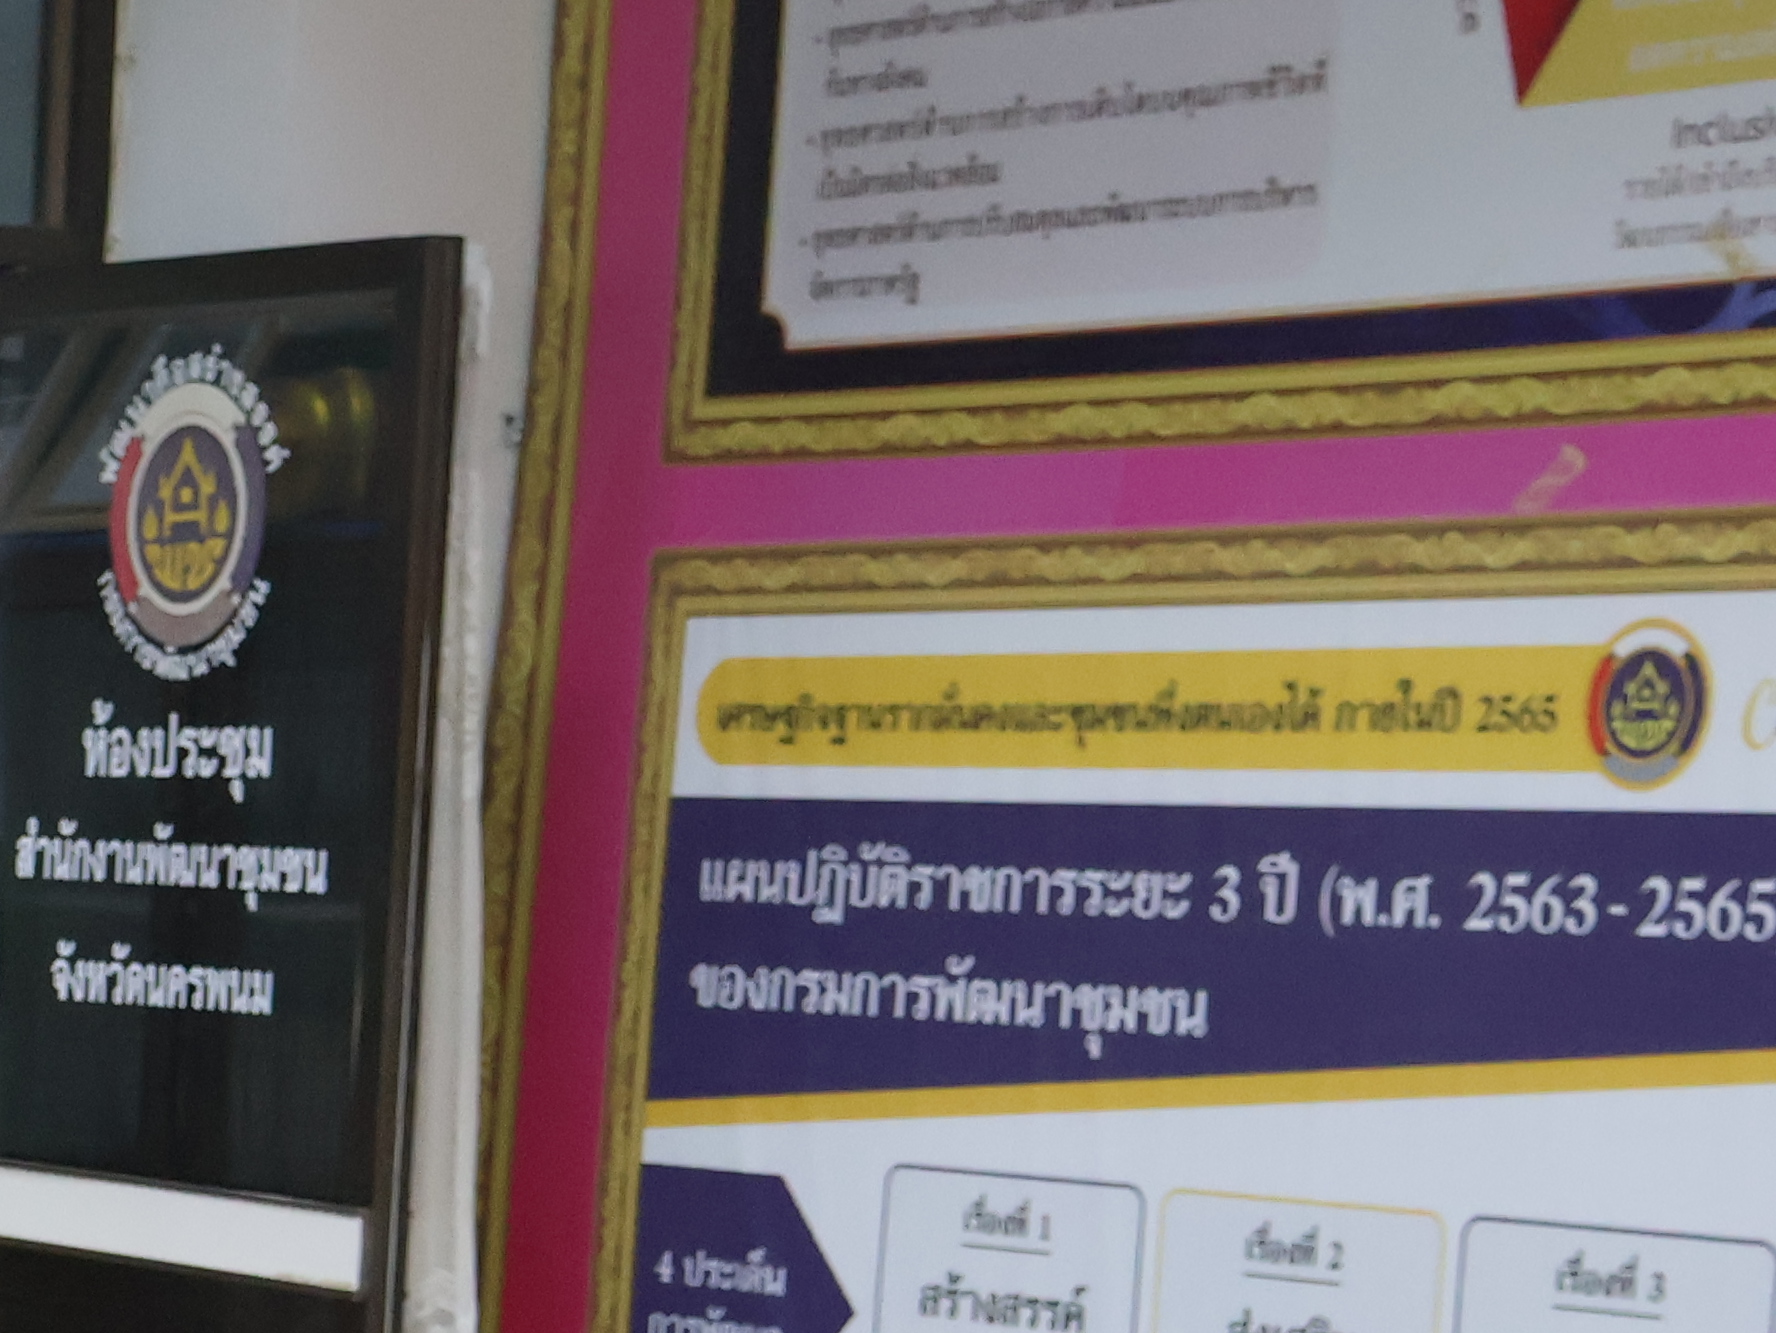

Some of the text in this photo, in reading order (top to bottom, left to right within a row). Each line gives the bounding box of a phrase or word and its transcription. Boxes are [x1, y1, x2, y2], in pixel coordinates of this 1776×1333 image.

[82, 699, 274, 803] ห้องประชุม
[1475, 693, 1559, 734] 2565
[14, 818, 329, 911] สำนักงานพัฒนาชุมชน
[698, 841, 1193, 926] แผนปฏิบัติราชการระยะ
[1208, 864, 1243, 923] 3
[1256, 850, 1301, 926] ปี
[1319, 863, 1443, 938] (พ.ศ.
[50, 939, 274, 1017] จังหวัดนครพนม
[688, 954, 1211, 1061] ของกรมการพัฒนาชุมชน
[653, 1246, 789, 1298] 4 ประเด็น
[1328, 1240, 1345, 1272] 2
[1647, 1270, 1667, 1304] 3
